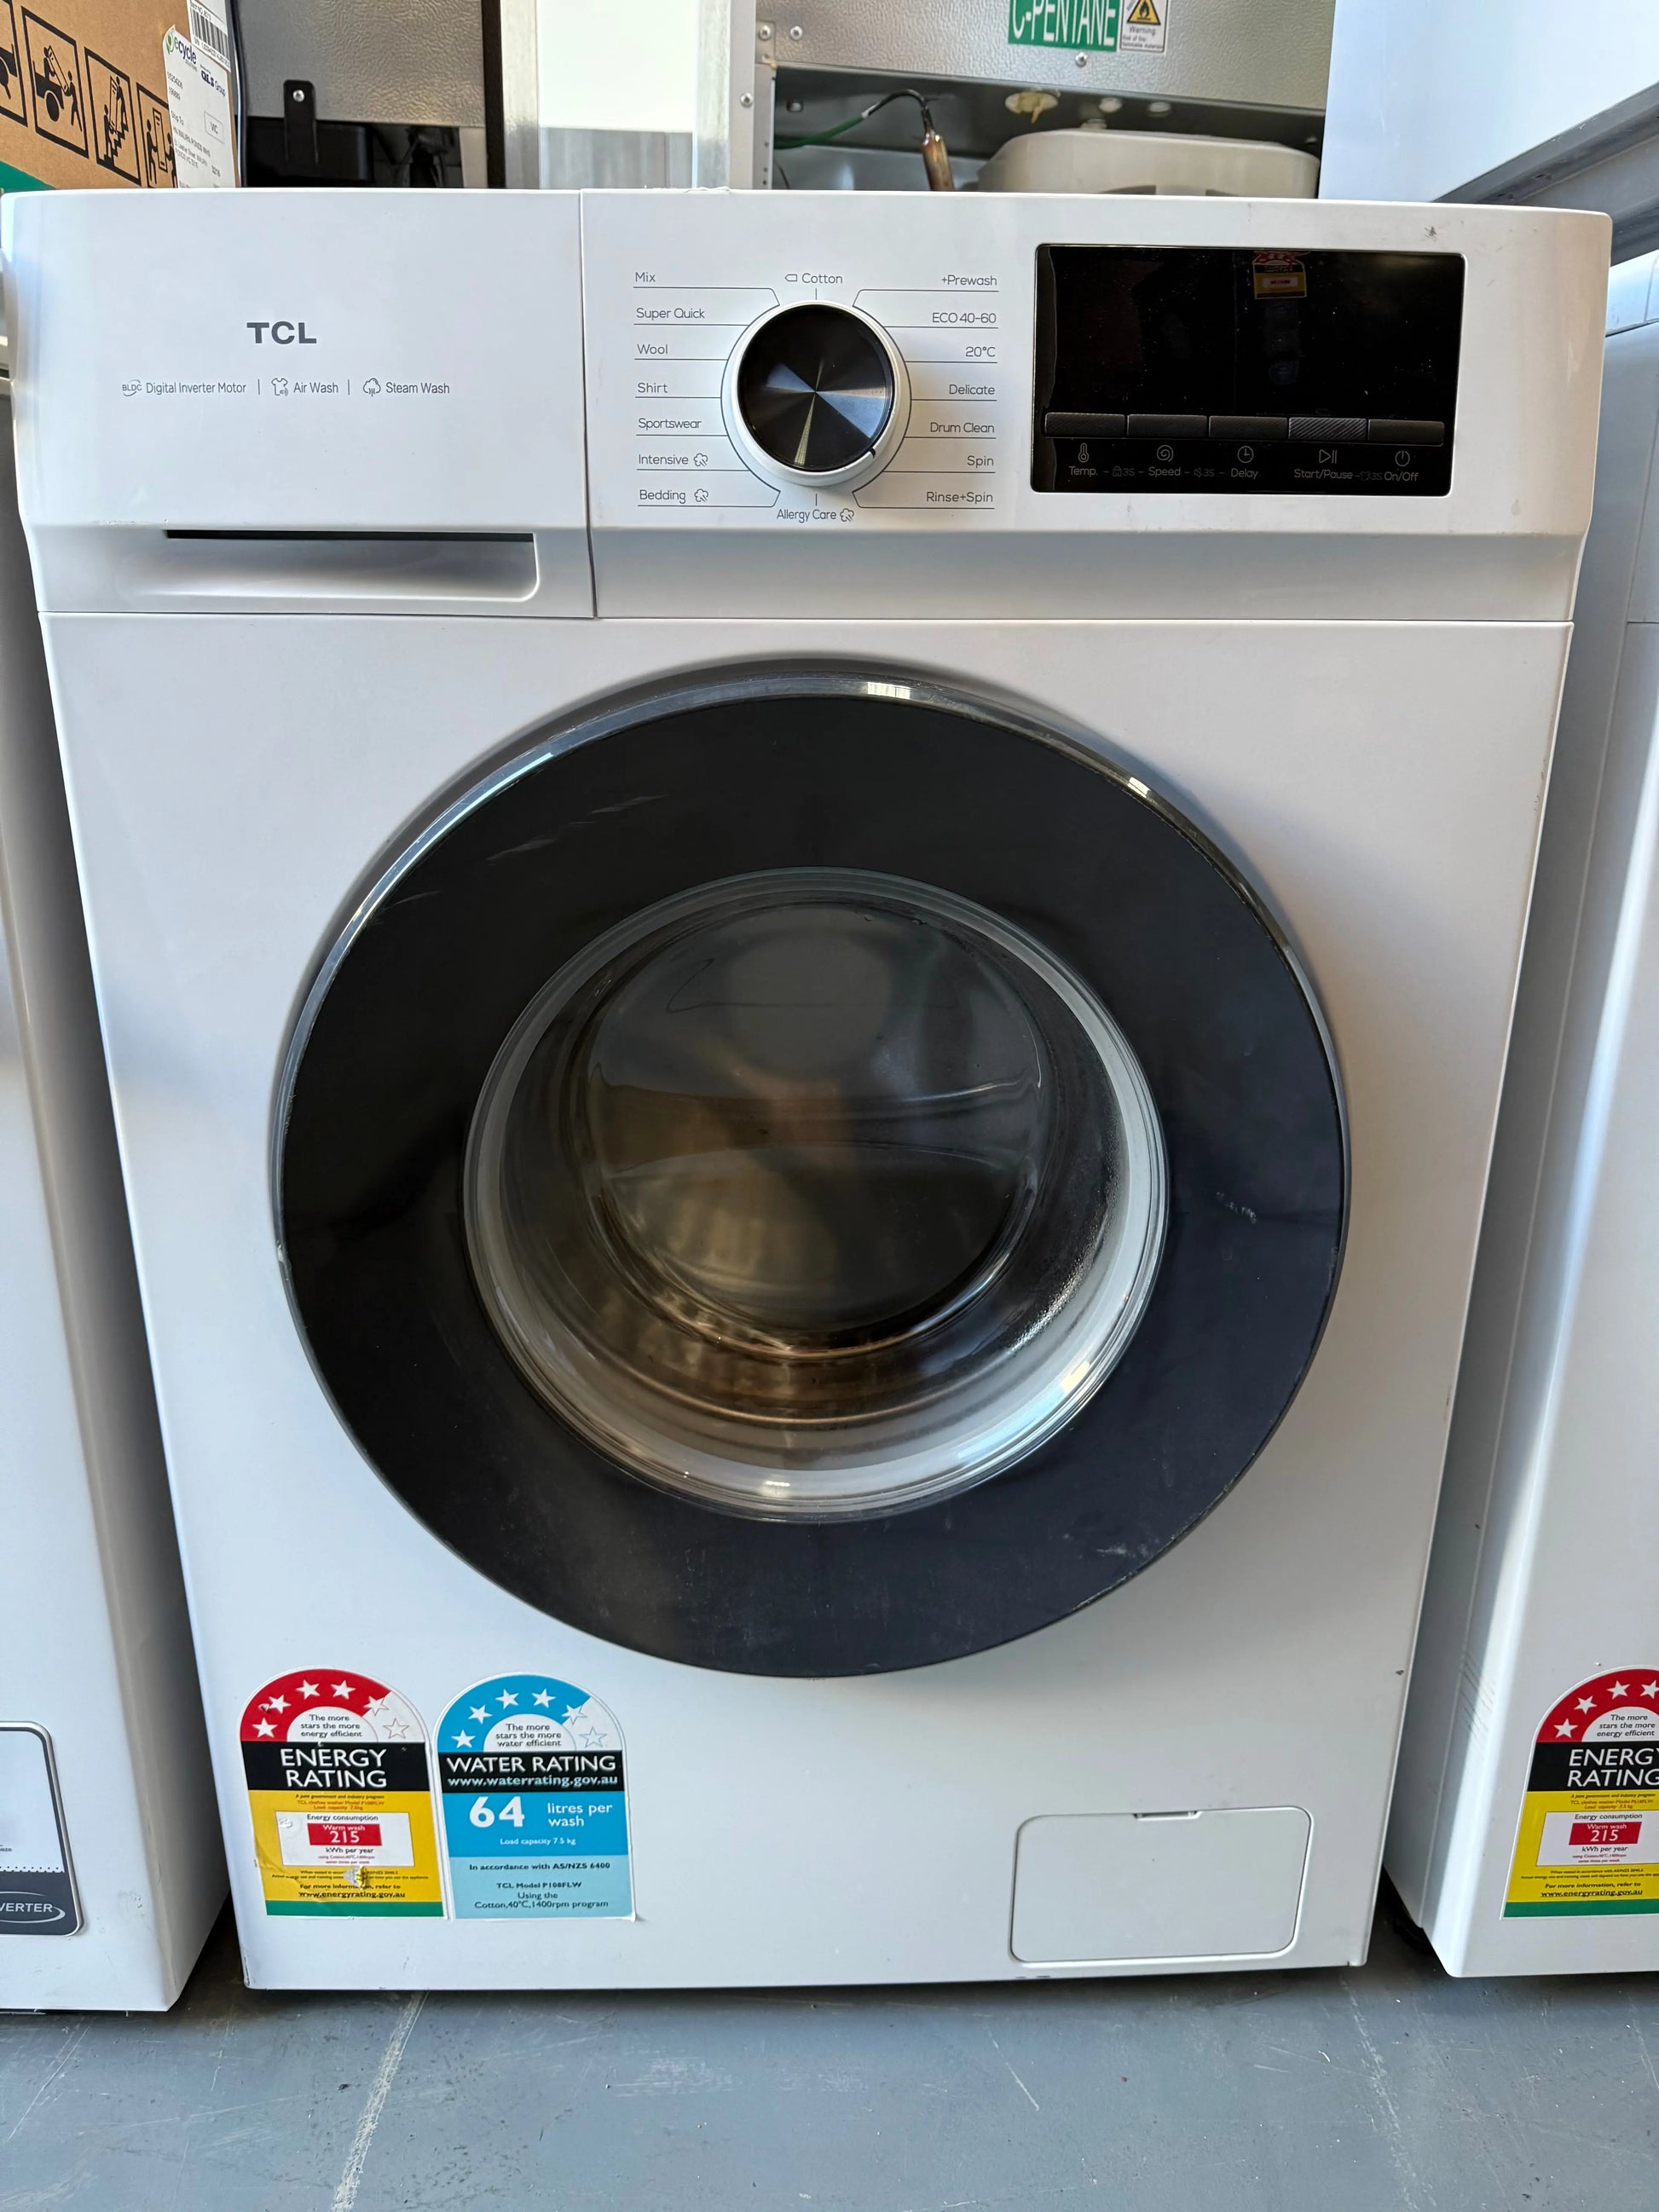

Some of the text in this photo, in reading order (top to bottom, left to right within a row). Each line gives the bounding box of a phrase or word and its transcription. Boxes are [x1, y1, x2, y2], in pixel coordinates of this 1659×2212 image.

[1129, 26, 1156, 37] Warning
[174, 36, 197, 64] ecycle
[635, 272, 656, 282] Mix
[801, 273, 843, 284] Cotton
[941, 274, 997, 286] +Prewash
[636, 308, 705, 321] Super Quick
[932, 313, 997, 323] ECO 40-60
[246, 321, 317, 344] TCL
[637, 344, 668, 355] Wool
[965, 346, 996, 357] 20°C
[146, 382, 246, 395] Digital Inverter Motor
[293, 382, 338, 393] Air Wash
[385, 382, 450, 394] Steam Wash
[638, 383, 668, 393] Shirt
[949, 384, 995, 395] Delicate
[638, 418, 702, 430] Sportswear
[930, 422, 995, 433] Drum Clean
[639, 453, 689, 465] Intensive
[967, 455, 994, 468] Spin
[1068, 465, 1098, 477] Temp.
[1148, 466, 1182, 477] Speed
[1230, 468, 1258, 480] Delay
[1294, 469, 1353, 480] Start/Pause
[1384, 471, 1419, 482] On/Off
[639, 489, 686, 504] Bedding
[927, 492, 993, 505] Rinse+Spin
[777, 509, 836, 523] Allergy Care
[280, 1748, 387, 1767] ENERGY
[1569, 1748, 1659, 1767] ENERG
[446, 1755, 616, 1773] WATER RATING
[286, 1770, 387, 1788] RATING
[448, 1774, 618, 1787] www.waterrating.gov.au
[1567, 1769, 1659, 1788] RATING
[469, 1796, 525, 1828] 64
[547, 1802, 613, 1818] litres per
[307, 1813, 331, 1822] Energy
[548, 1816, 585, 1828] wash
[330, 1831, 360, 1843] 215
[1590, 1829, 1619, 1842] 215
[517, 1891, 542, 1900] Using
[1540, 1889, 1644, 1897] www.energyrating.gov.au
[572, 1901, 609, 1909] program
